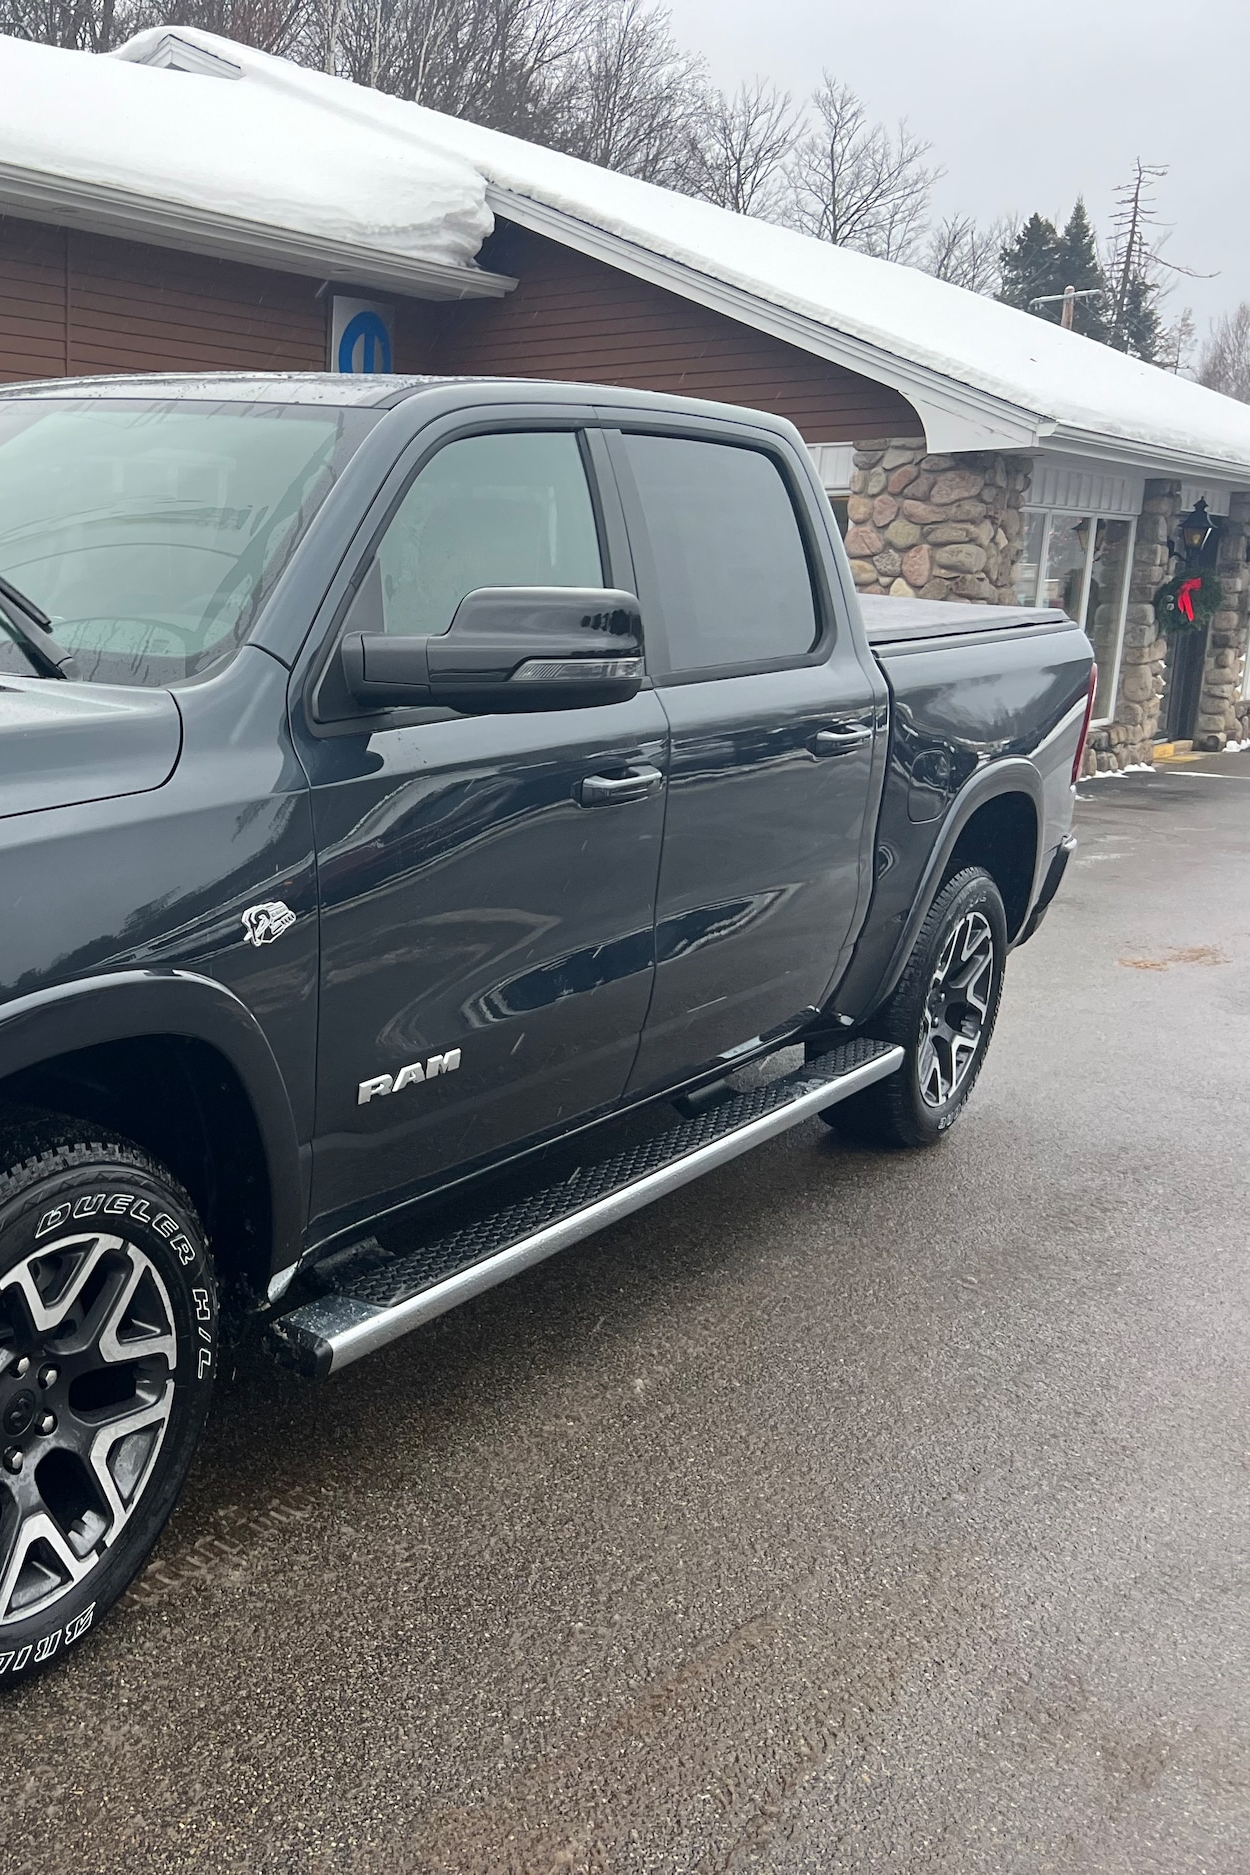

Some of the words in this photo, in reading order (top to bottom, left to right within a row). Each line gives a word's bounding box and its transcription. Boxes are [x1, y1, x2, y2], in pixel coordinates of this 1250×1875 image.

[357, 1047, 462, 1105] RAM
[35, 1193, 196, 1266] DUELER
[192, 1288, 212, 1379] H/L
